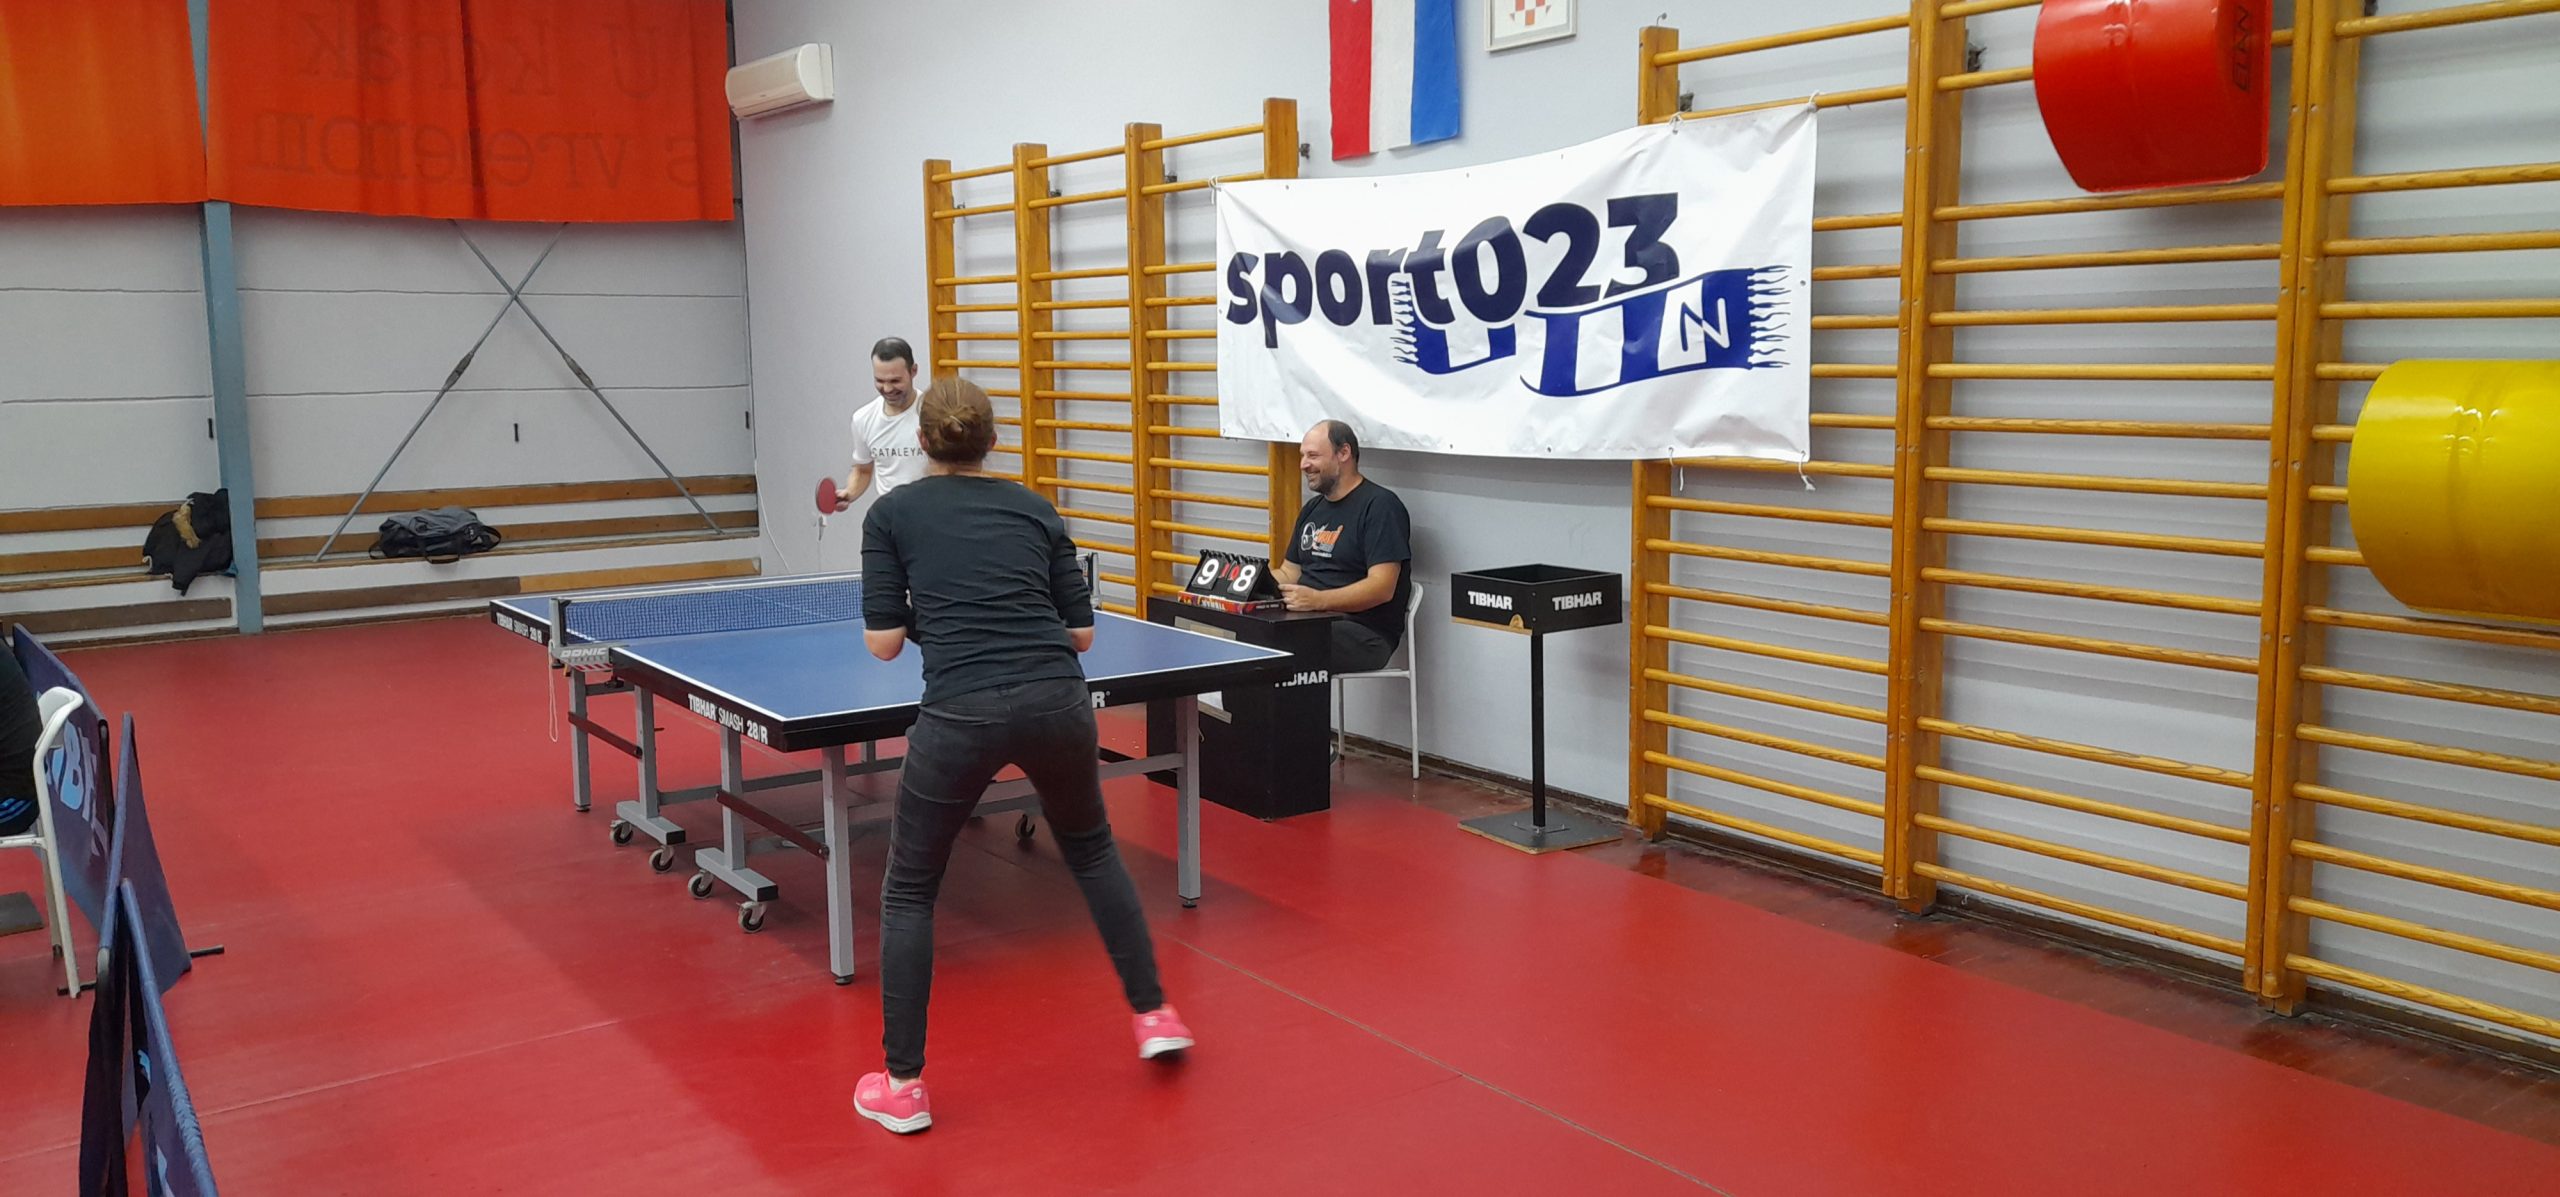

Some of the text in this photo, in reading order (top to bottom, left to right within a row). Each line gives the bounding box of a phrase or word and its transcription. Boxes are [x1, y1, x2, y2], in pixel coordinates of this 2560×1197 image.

[1225, 192, 1681, 349] sport023
[1197, 558, 1220, 585] 9
[1232, 564, 1257, 592] 8
[1467, 590, 1513, 611] TIBHAR
[1551, 591, 1603, 611] TIBHAR
[560, 647, 608, 658] DONIC
[687, 693, 718, 721] TIBHAR
[718, 707, 744, 734] SMASH
